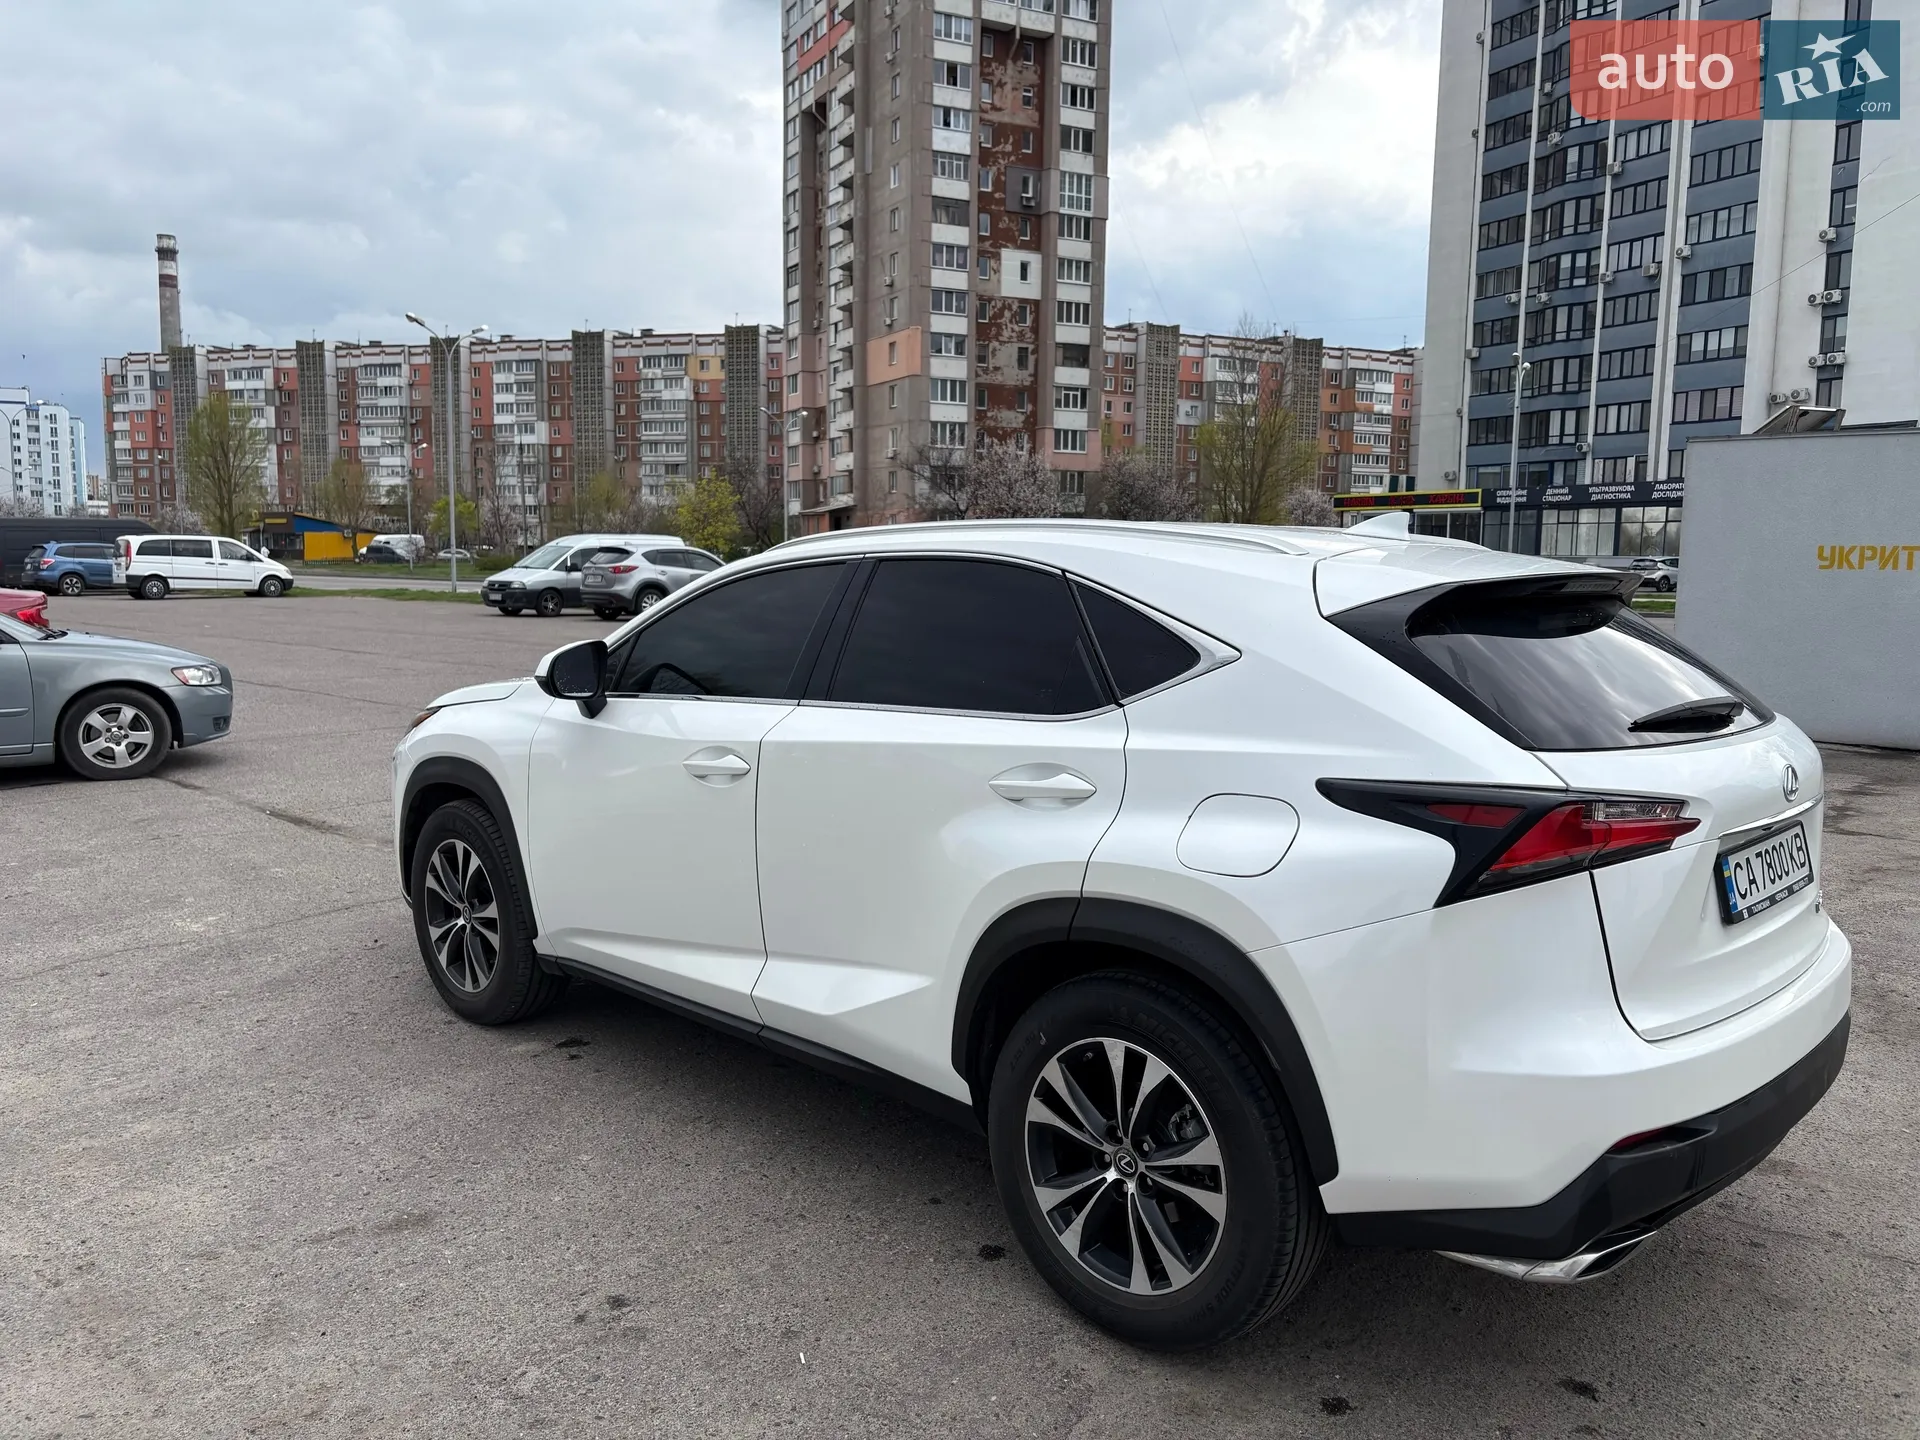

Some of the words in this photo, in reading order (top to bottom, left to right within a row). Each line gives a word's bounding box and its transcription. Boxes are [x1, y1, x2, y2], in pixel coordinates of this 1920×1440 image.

[1546, 487, 1569, 495] ДЕННИЙ
[1589, 485, 1635, 493] УЛЬТРАЗВУКОВА
[1590, 493, 1631, 501] ДІАГНОСТИКА
